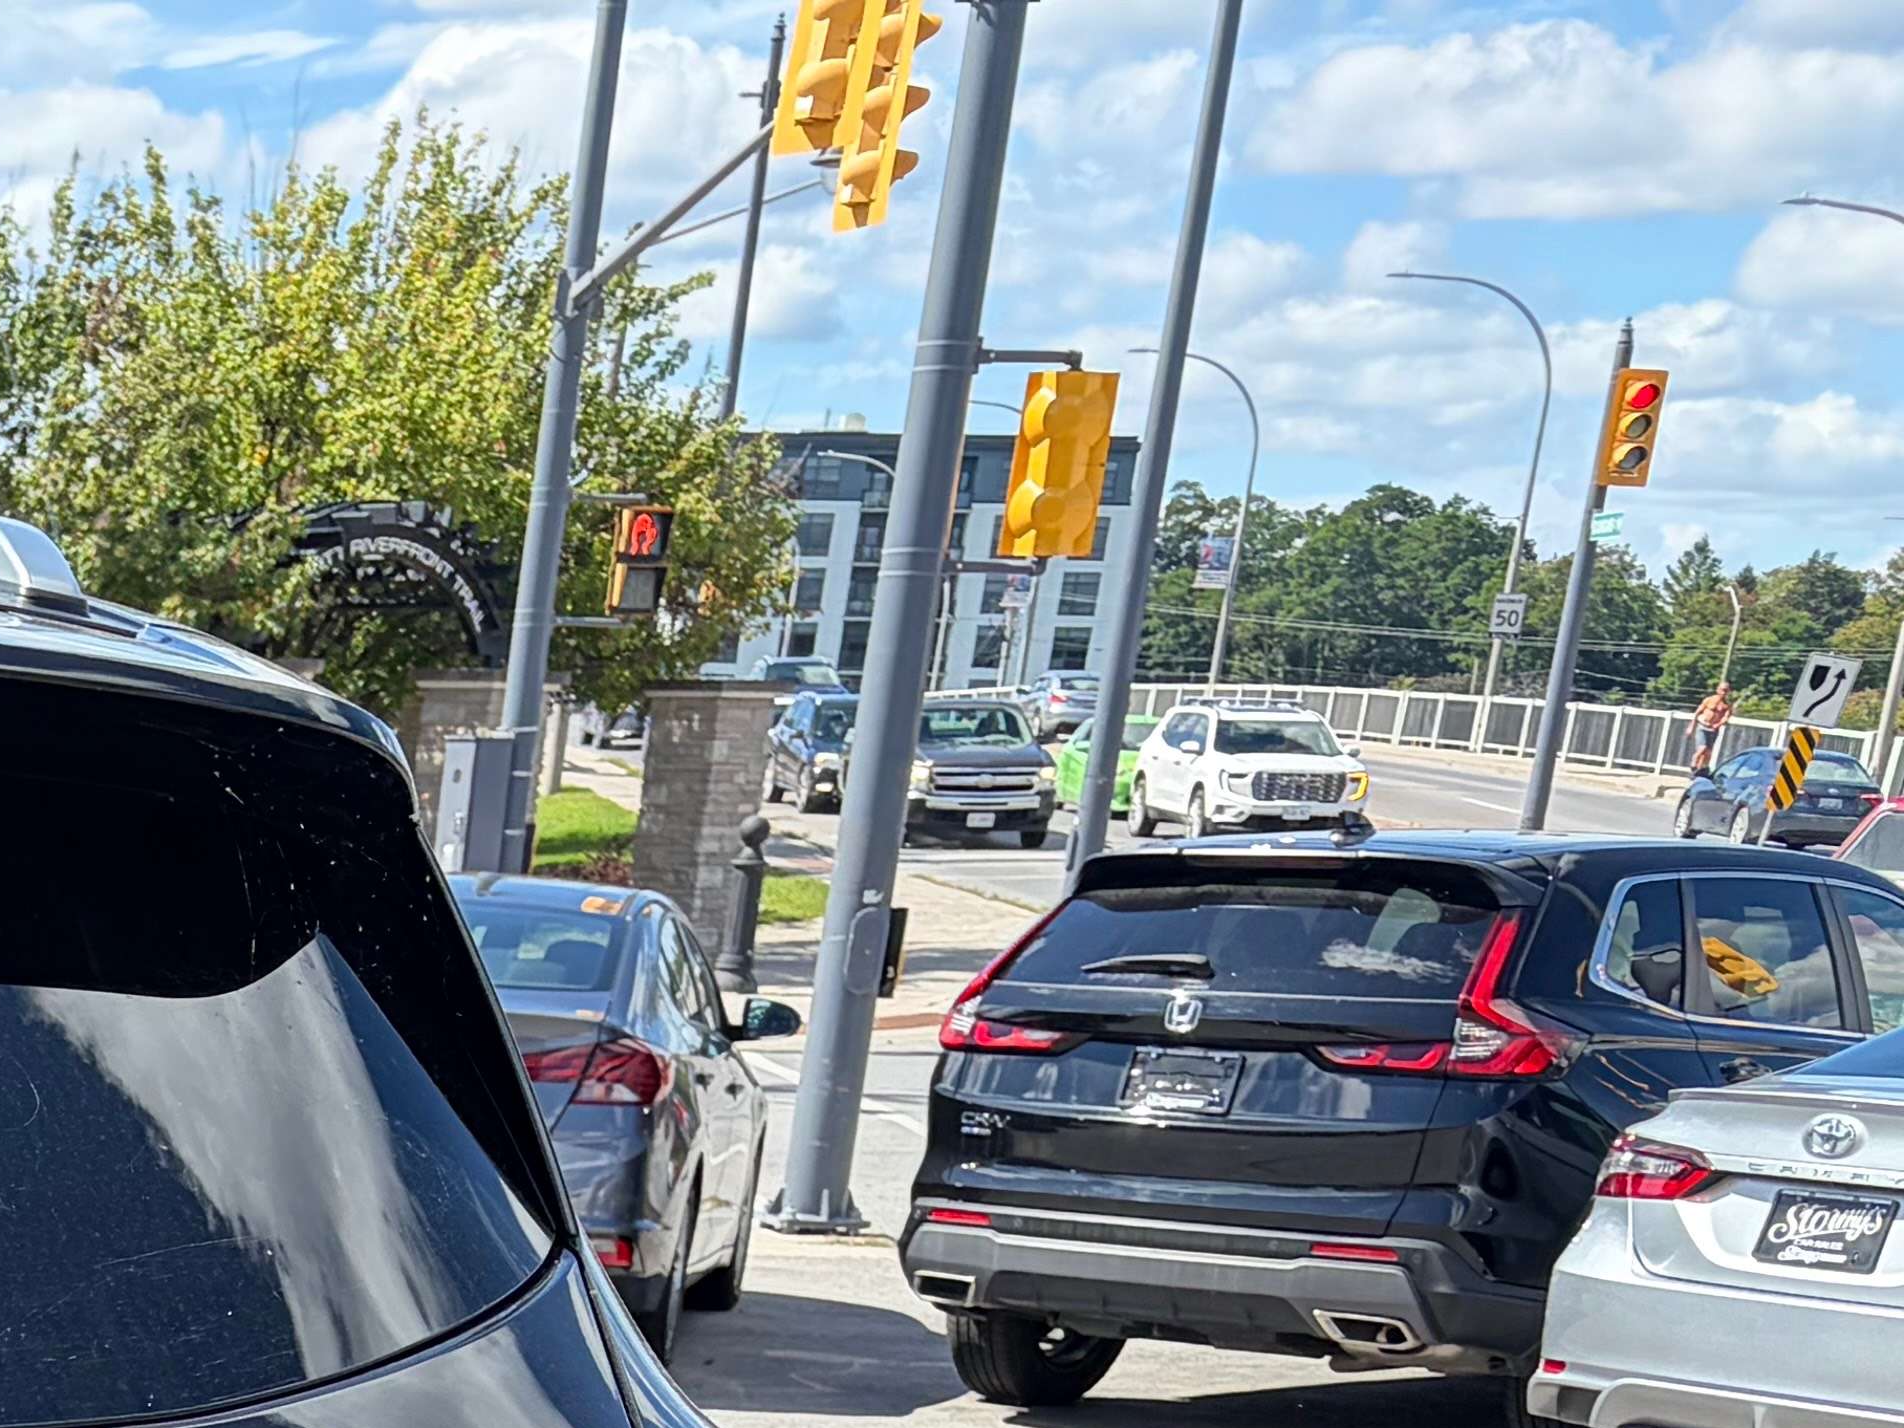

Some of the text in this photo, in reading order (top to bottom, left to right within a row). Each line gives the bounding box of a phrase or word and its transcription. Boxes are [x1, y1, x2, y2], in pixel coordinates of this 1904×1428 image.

[349, 536, 454, 579] RIVERFRONT
[452, 573, 485, 633] TRAIL
[1494, 609, 1520, 628] 50
